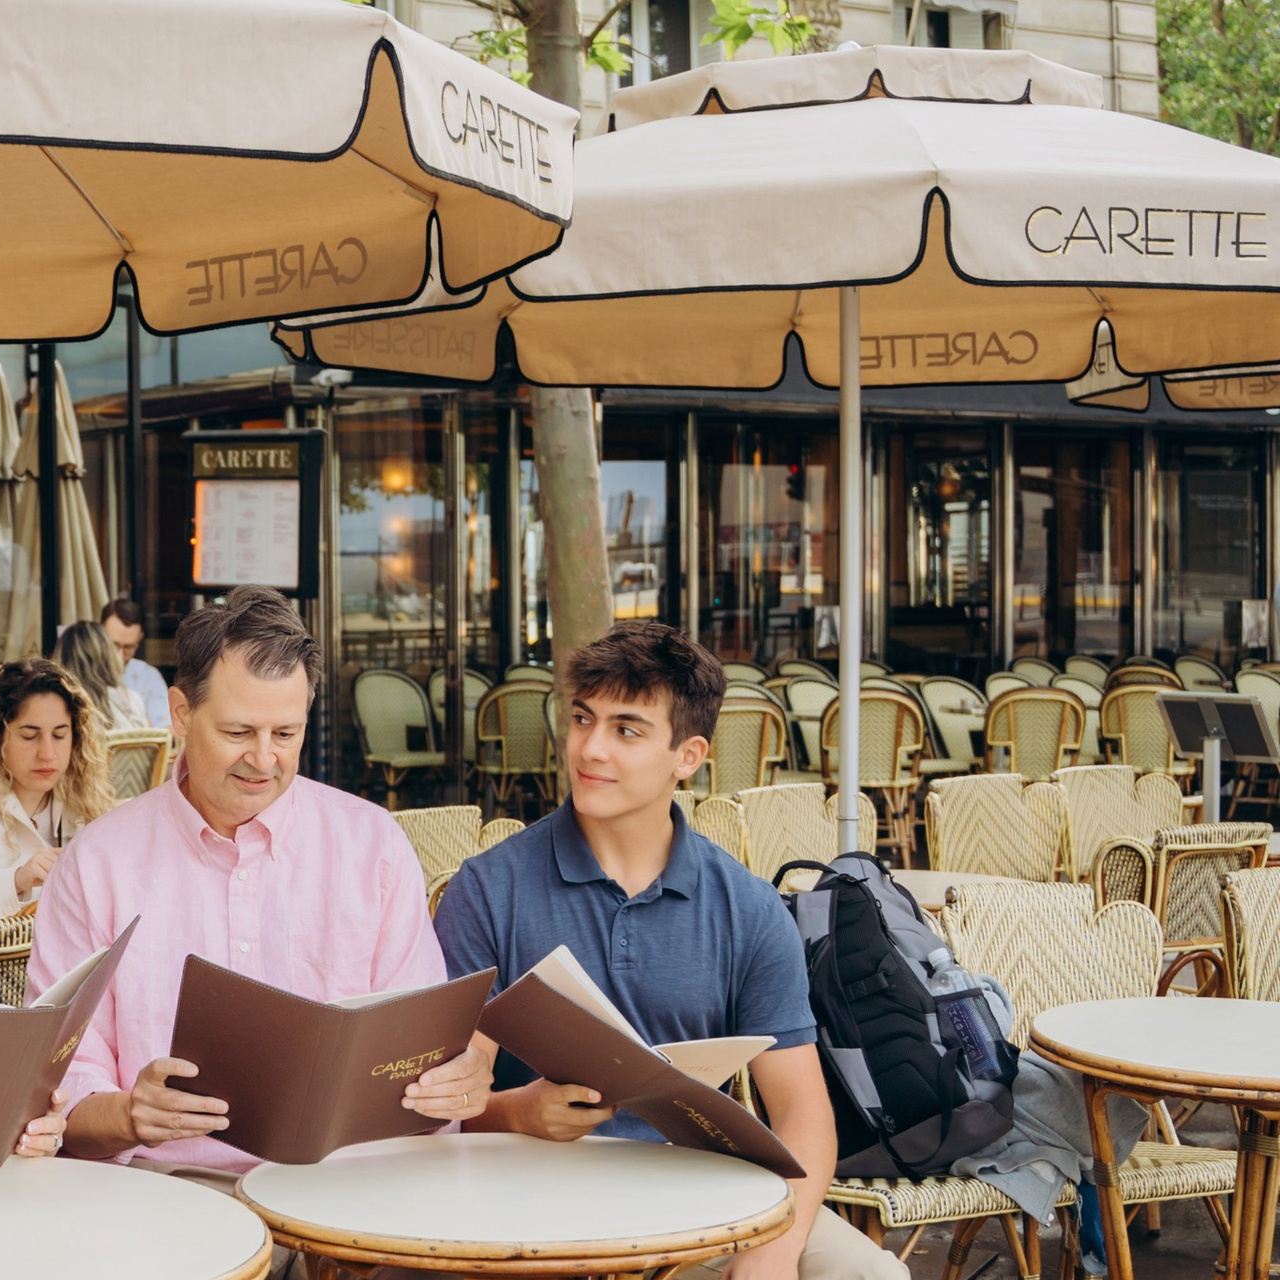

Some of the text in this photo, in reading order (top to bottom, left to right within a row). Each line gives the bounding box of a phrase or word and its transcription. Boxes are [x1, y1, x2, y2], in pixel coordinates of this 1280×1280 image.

[441, 80, 553, 184] CARETTE
[1024, 205, 1268, 259] CARETTE
[201, 448, 294, 469] CARETTE
[370, 1046, 446, 1076] CARETTE
[389, 1066, 424, 1081] PARIS
[673, 1099, 740, 1152] CARETTE
